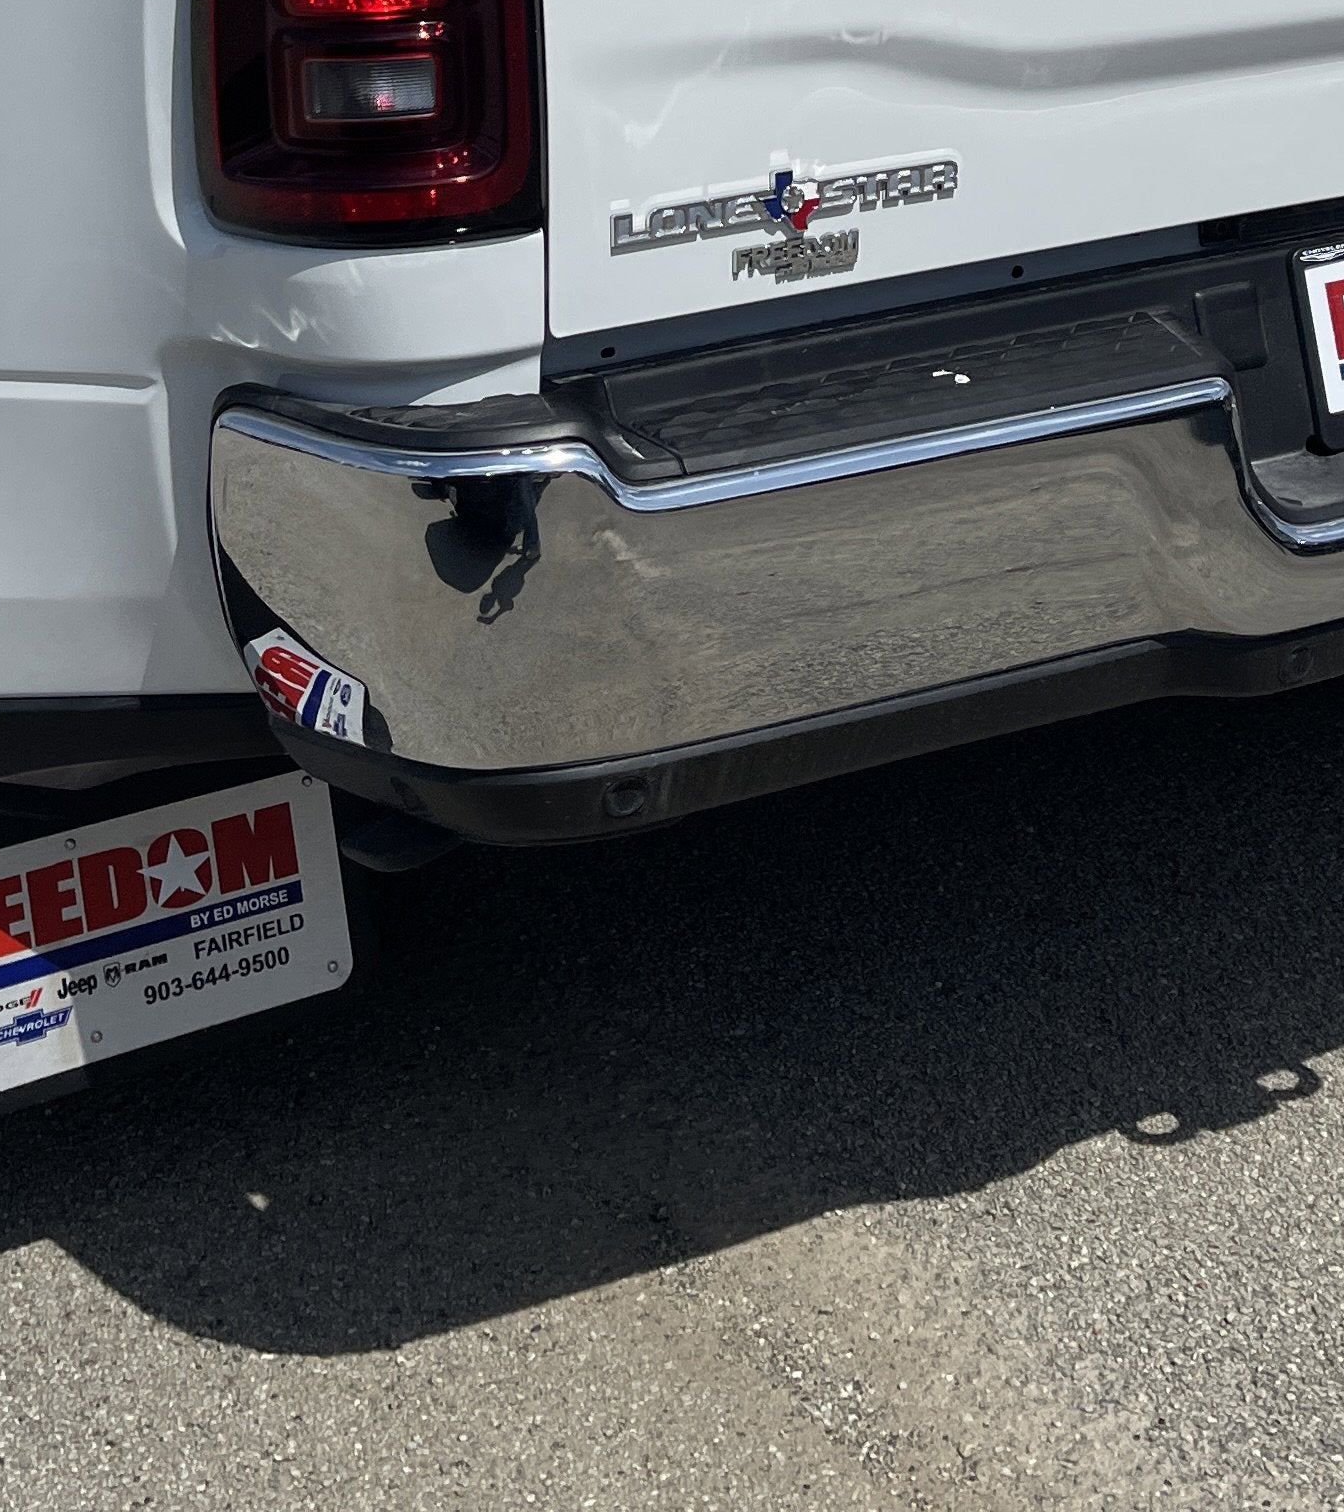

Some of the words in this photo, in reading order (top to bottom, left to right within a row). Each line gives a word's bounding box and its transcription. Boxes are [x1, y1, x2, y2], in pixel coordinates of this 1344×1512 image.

[610, 195, 763, 251] LONE
[819, 159, 959, 214] STAR
[190, 912, 211, 929] BY
[213, 905, 234, 922] ED
[237, 889, 289, 915] MORSE
[193, 913, 304, 960] FAIRFIELD
[57, 974, 98, 1000] Jeep
[124, 953, 169, 975] RAM
[144, 946, 290, 1005] 903-644-9500
